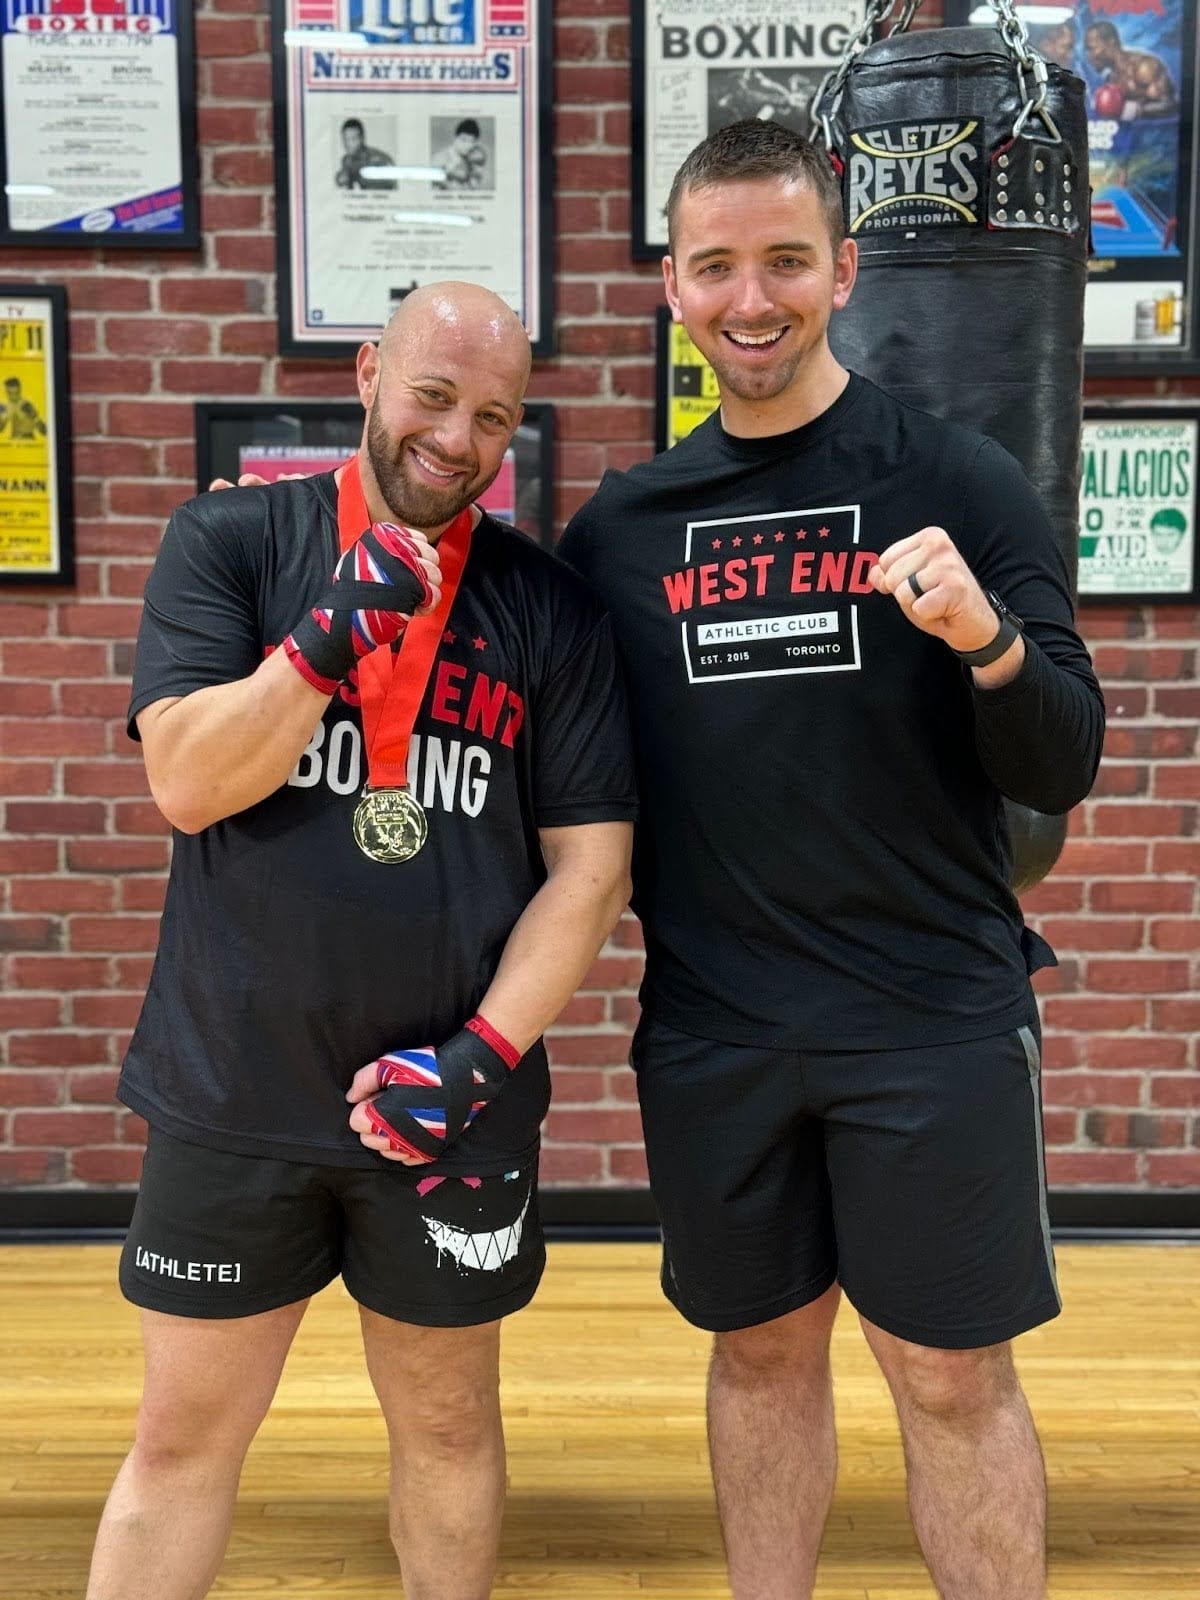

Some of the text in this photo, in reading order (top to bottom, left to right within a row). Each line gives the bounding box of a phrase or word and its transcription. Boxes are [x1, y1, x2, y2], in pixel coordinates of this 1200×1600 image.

[27, 17, 152, 32] BOXING
[414, 26, 464, 42] BEER
[662, 24, 851, 59] BOXING
[370, 64, 391, 79] AT
[397, 64, 434, 79] THE
[850, 142, 979, 227] REYES
[865, 212, 961, 230] PROFESIONAL
[1096, 426, 1185, 440] CHAMPIONSHIP
[662, 551, 879, 615] WEST END
[705, 617, 828, 640] ATHLETIC CLUB
[700, 652, 750, 665] EST. 2015
[785, 644, 841, 657] TORONTO
[287, 720, 492, 819] BOING
[136, 1246, 241, 1283] [ATHLETE]
